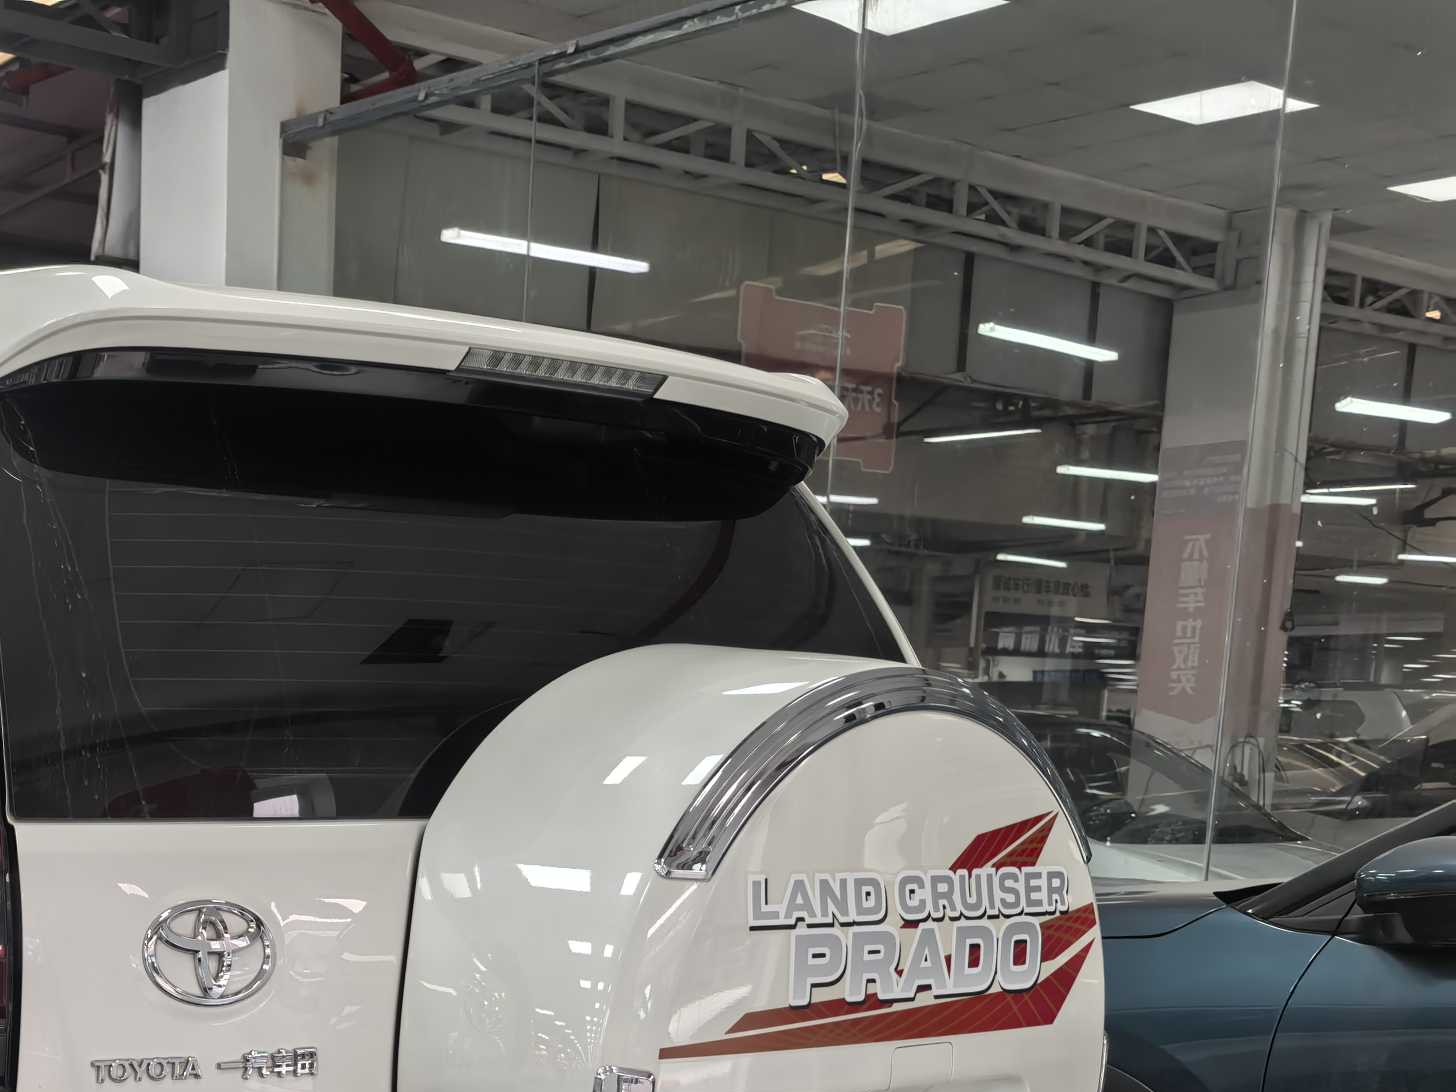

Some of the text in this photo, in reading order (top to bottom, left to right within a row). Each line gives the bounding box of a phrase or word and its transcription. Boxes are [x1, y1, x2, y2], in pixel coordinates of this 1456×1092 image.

[748, 866, 1070, 931] LAND CRUISER
[789, 917, 1042, 1008] PRADO
[91, 1056, 202, 1084] TOYOTA
